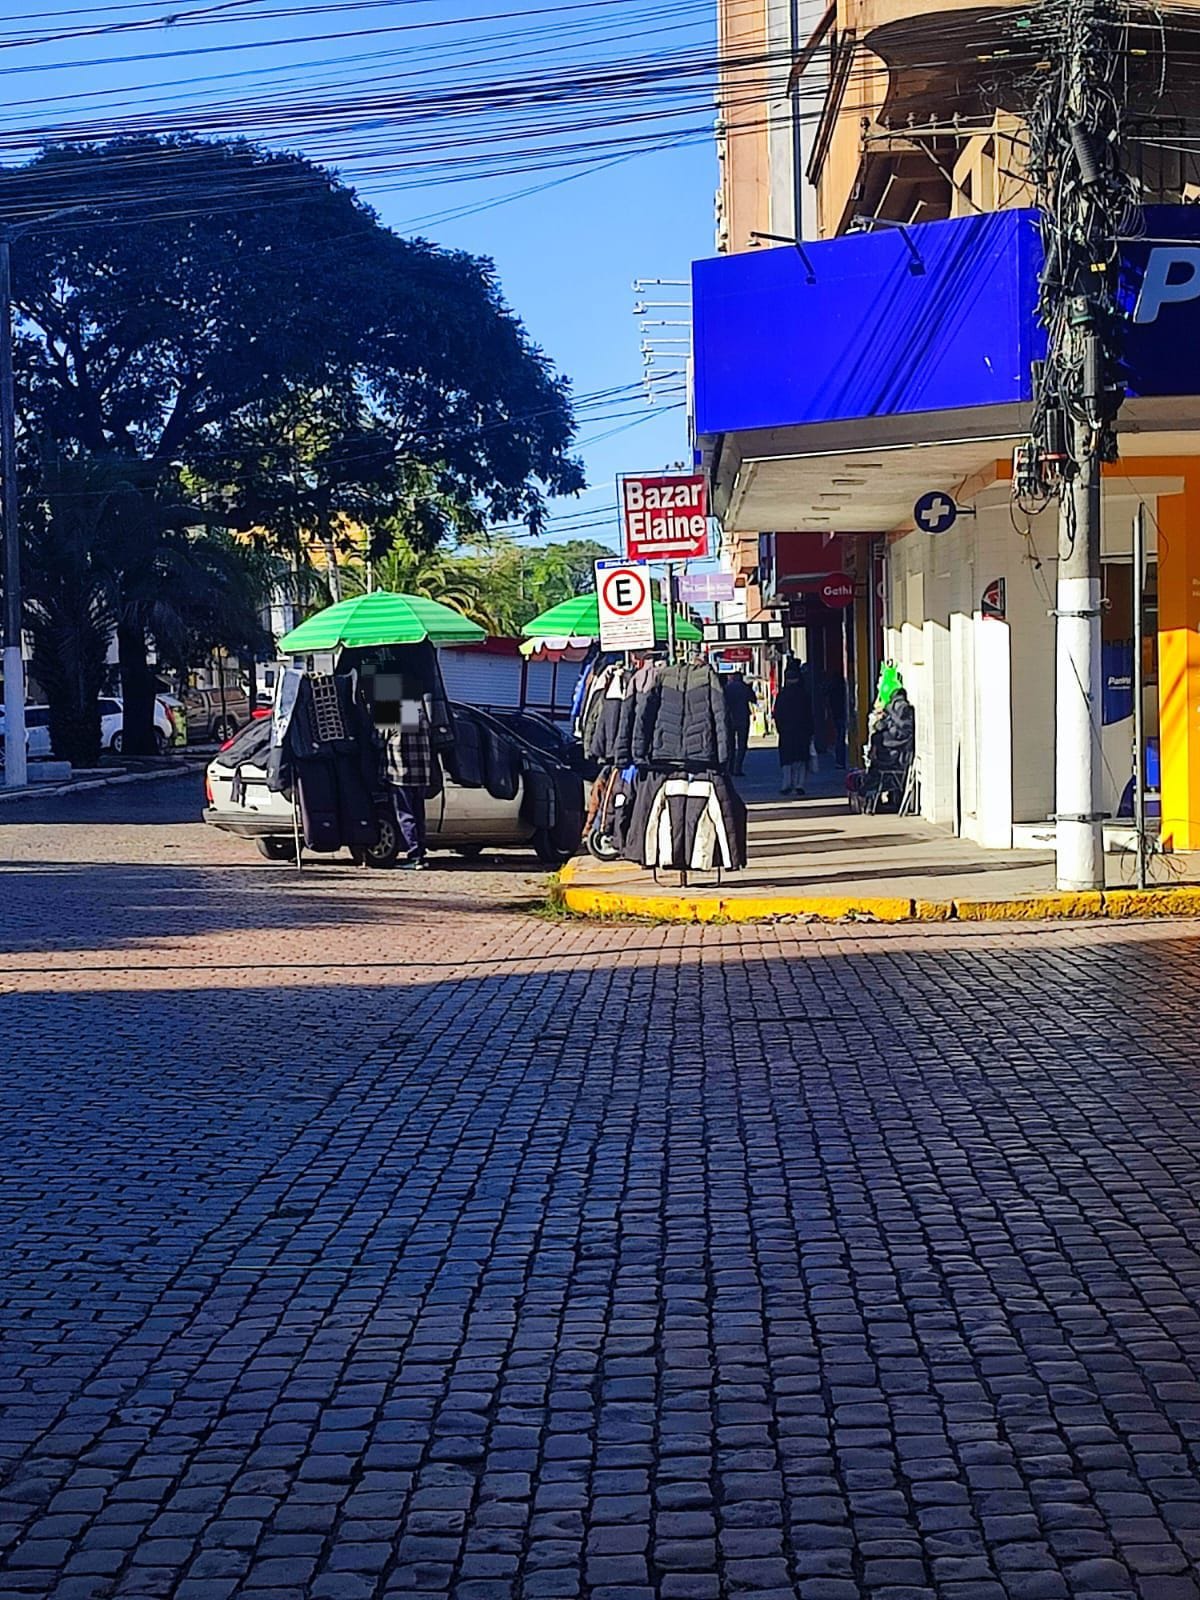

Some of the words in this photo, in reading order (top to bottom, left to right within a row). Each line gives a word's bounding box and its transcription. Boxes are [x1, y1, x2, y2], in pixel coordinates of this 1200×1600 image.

[626, 482, 702, 511] Bazar
[629, 510, 706, 541] Elaine
[615, 579, 633, 606] E
